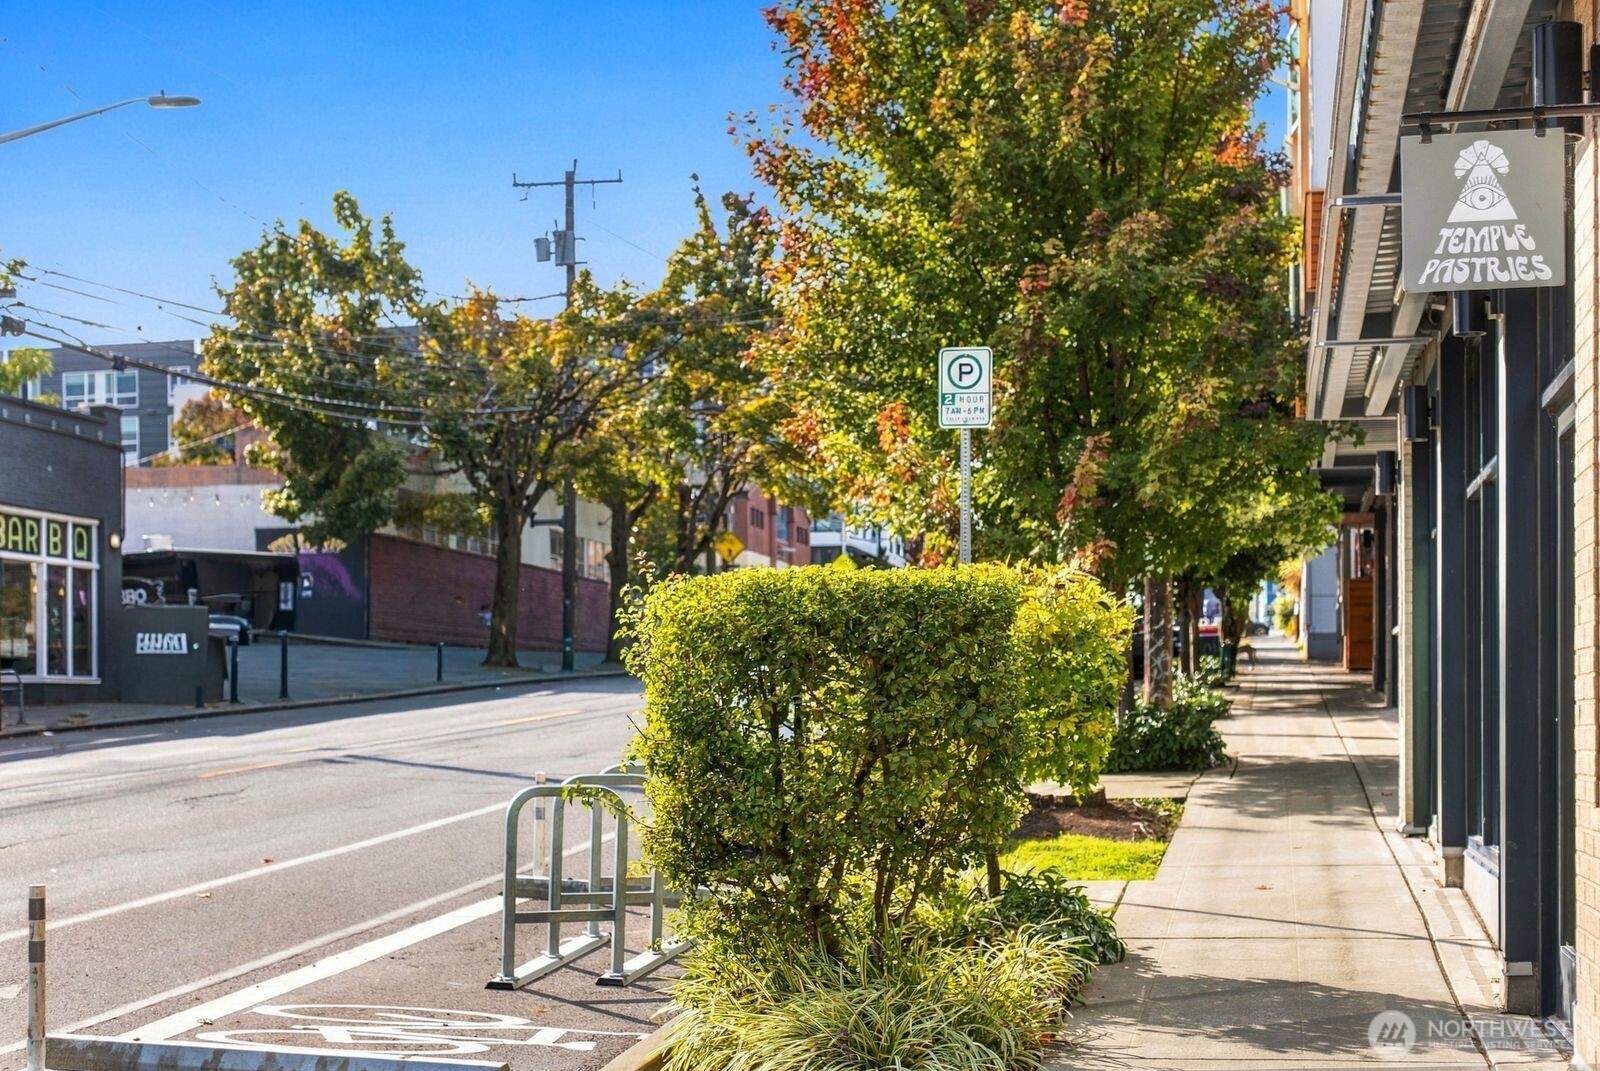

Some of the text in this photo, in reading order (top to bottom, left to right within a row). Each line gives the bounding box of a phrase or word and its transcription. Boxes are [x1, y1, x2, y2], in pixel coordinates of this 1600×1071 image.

[1434, 224, 1536, 254] TEMPLE
[1417, 255, 1553, 285] PASTRIES
[958, 363, 974, 382] P
[944, 394, 985, 404] 2 HOUR
